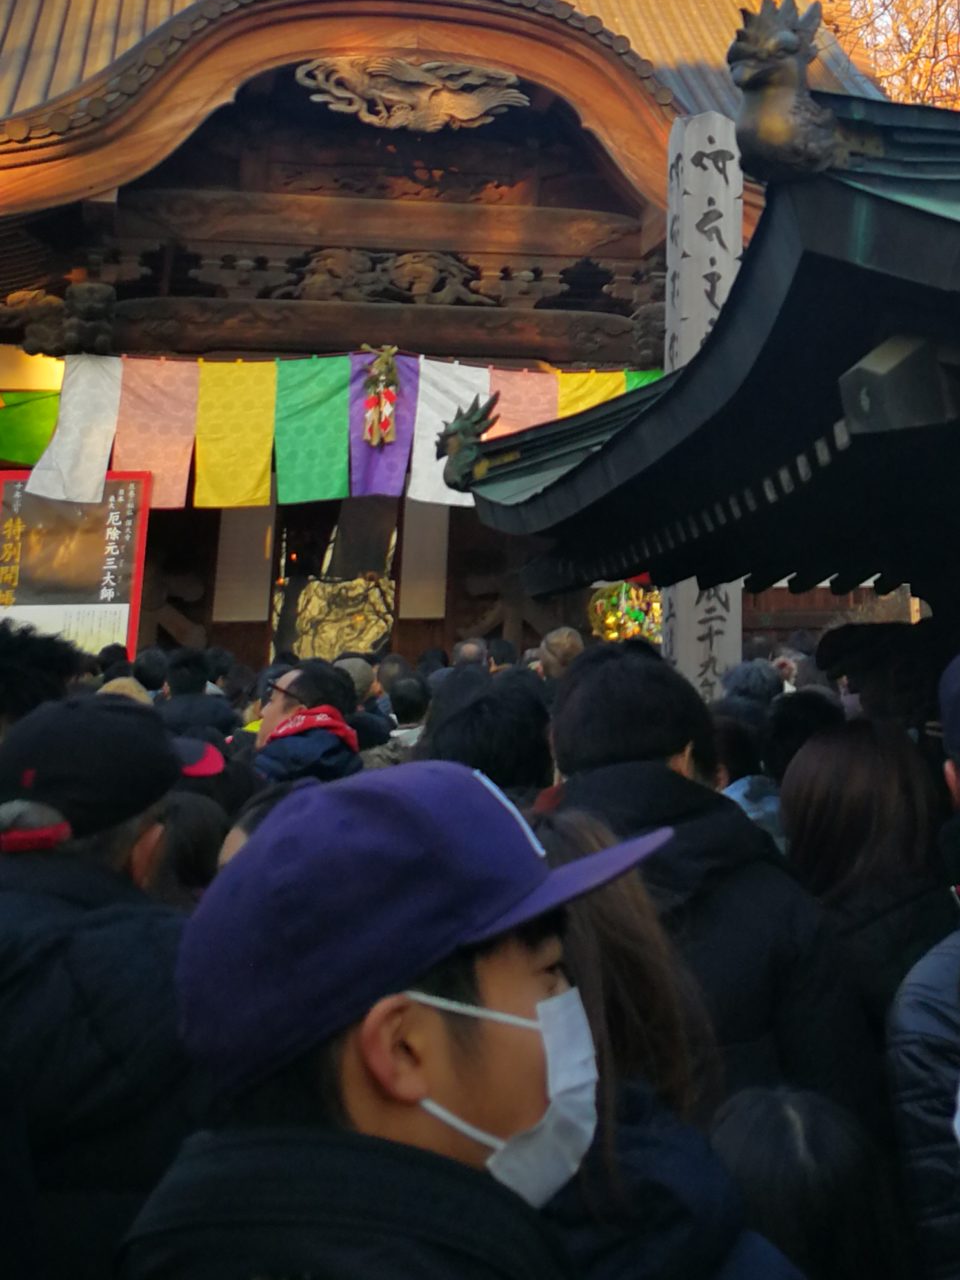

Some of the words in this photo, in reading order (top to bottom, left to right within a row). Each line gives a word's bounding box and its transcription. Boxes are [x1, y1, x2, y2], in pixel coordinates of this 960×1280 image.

[100, 511, 122, 602] 厄除元三大師
